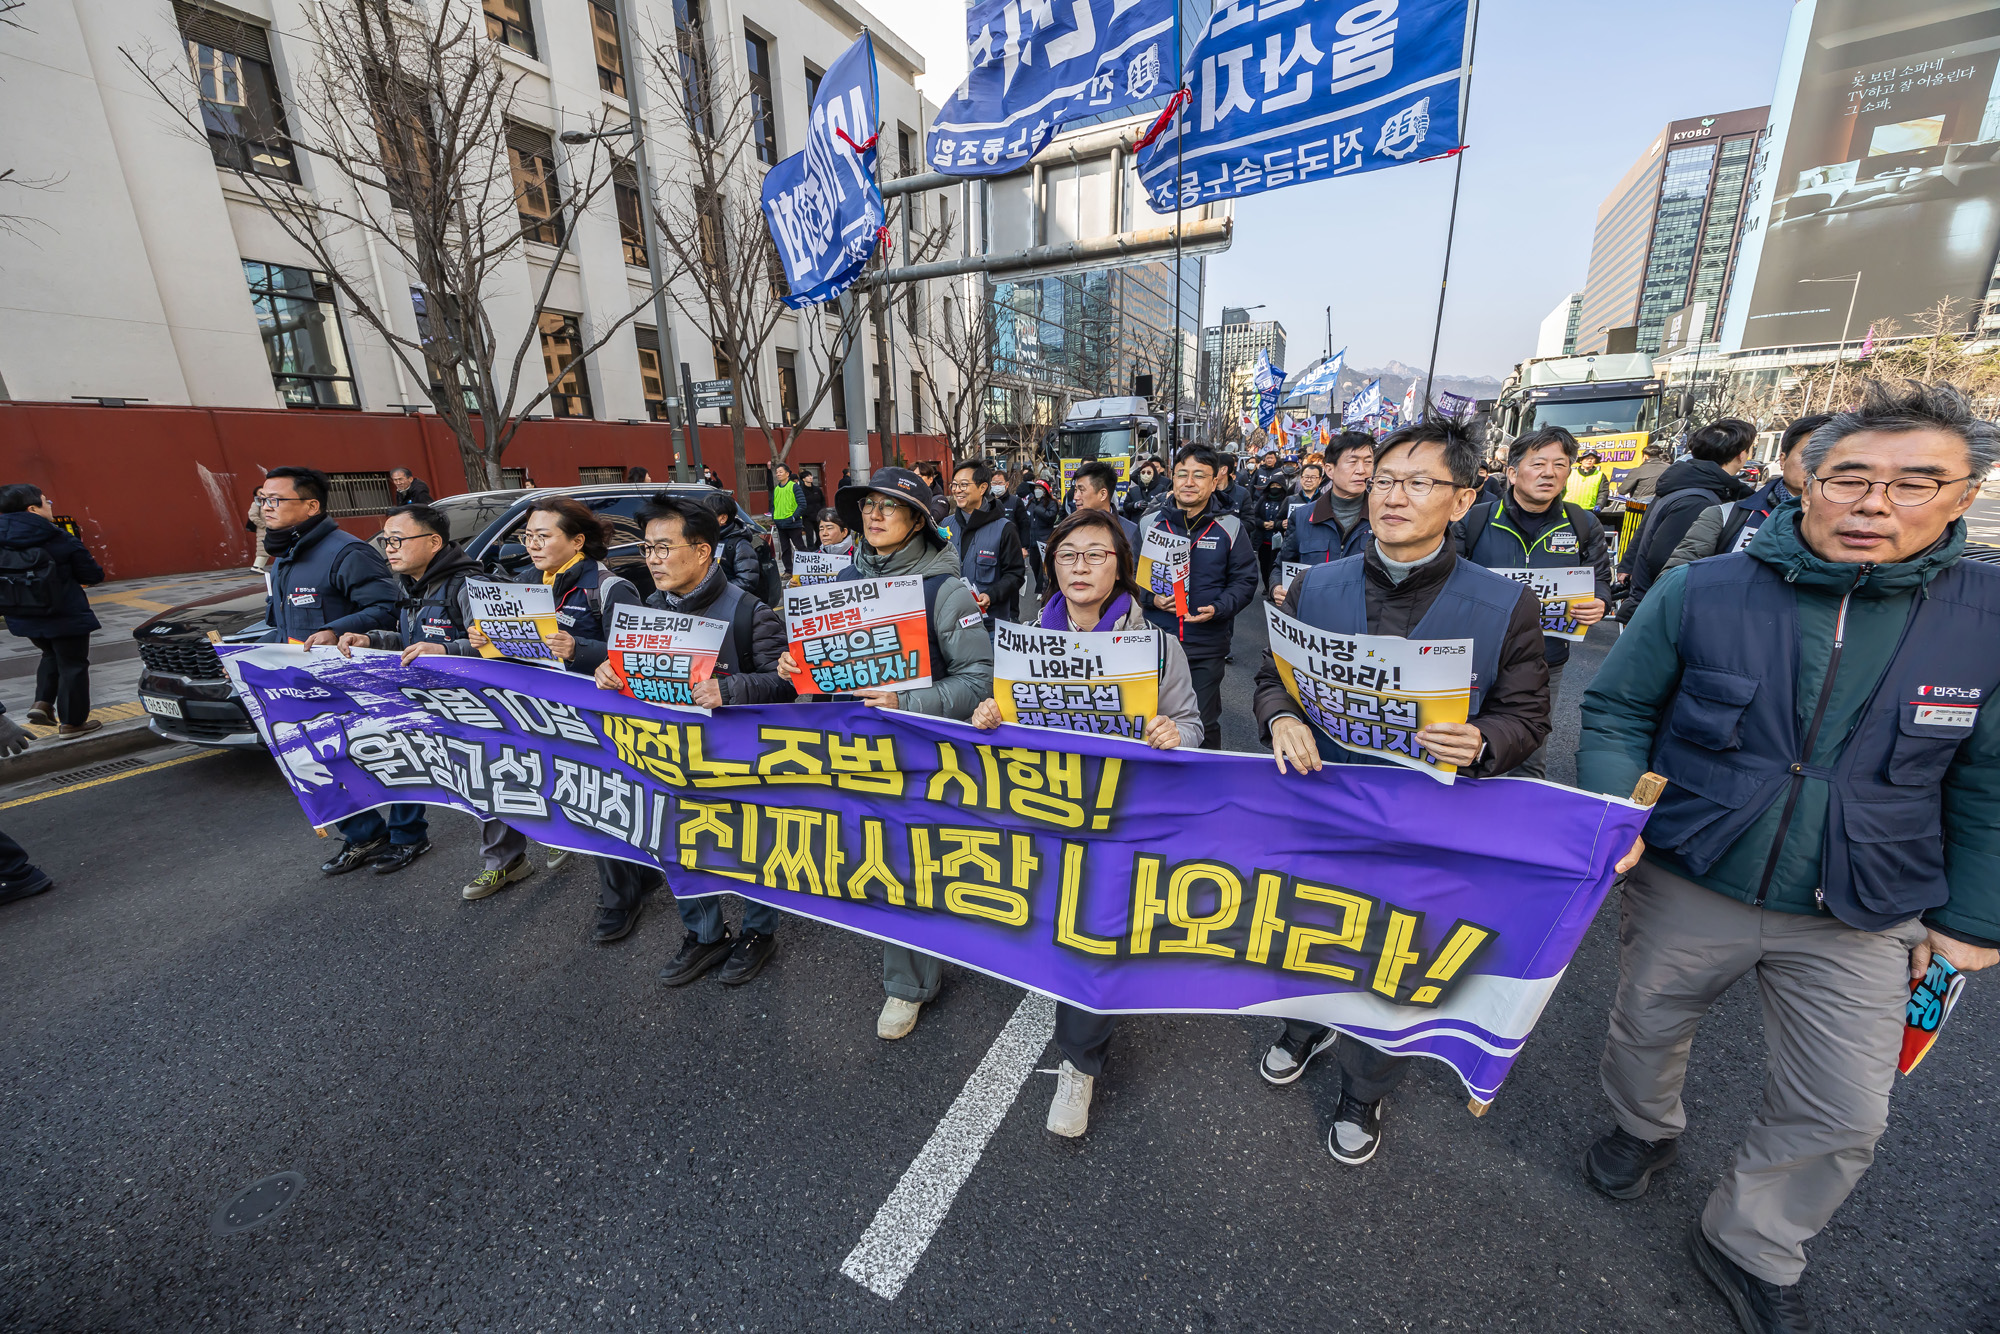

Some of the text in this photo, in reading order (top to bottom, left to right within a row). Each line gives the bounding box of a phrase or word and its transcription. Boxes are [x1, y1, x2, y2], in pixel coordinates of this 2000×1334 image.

[1847, 65, 1976, 102] TV하고 잘 어울린다
[1867, 67, 1897, 84] 보던
[1899, 57, 1944, 77] 소파네
[1861, 97, 1892, 113] 소파.
[1673, 128, 1711, 141] KYOBO
[795, 553, 820, 565] 진짜사장
[806, 562, 833, 575] 나와라!
[468, 578, 502, 601] 진짜사장
[894, 579, 919, 589] 민주노총
[484, 599, 525, 618] 나와라!
[787, 581, 881, 618] 모든 노동자의
[480, 619, 541, 642] 원청교섭
[614, 611, 694, 633] 모든 노동자의
[790, 605, 863, 640] 노동기본권
[614, 632, 673, 650] 노동기본권
[801, 623, 902, 666] 투쟁으로
[997, 626, 1067, 657] 진짜사장
[1123, 635, 1153, 645] 민주노총
[1269, 611, 1358, 662] 진짜사장
[1433, 646, 1466, 656] 민주노총
[622, 651, 693, 679] 투쟁으로
[809, 649, 920, 694] 쟁취하자!
[1028, 655, 1105, 681] 나와라!
[1308, 655, 1401, 692] 나와라!
[627, 677, 695, 706] 쟁취하자
[1011, 681, 1123, 713] 원청교섭
[1291, 667, 1419, 730] 원청교섭
[1933, 686, 1982, 699] 민주노총
[482, 688, 600, 746] 10일
[926, 742, 1123, 830] 시행!
[349, 730, 1490, 1004] 원청교섭 쟁취! 진짜사장 나와라!
